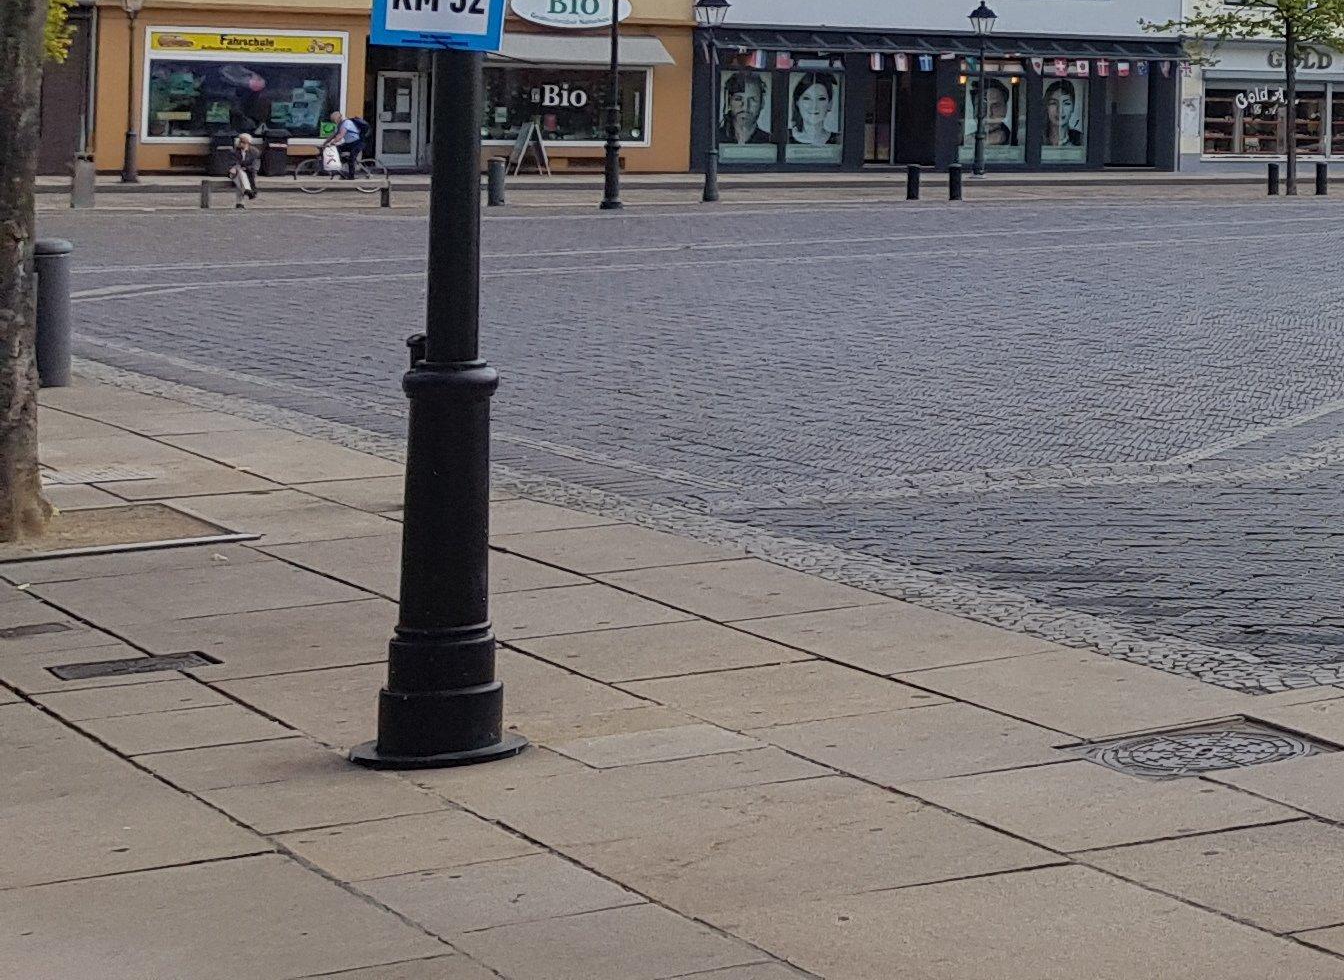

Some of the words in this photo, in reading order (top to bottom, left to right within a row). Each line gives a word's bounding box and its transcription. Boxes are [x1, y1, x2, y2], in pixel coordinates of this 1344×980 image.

[220, 33, 275, 48] Fahrschule
[542, 83, 587, 107] Bio
[1235, 86, 1269, 109] Gold
